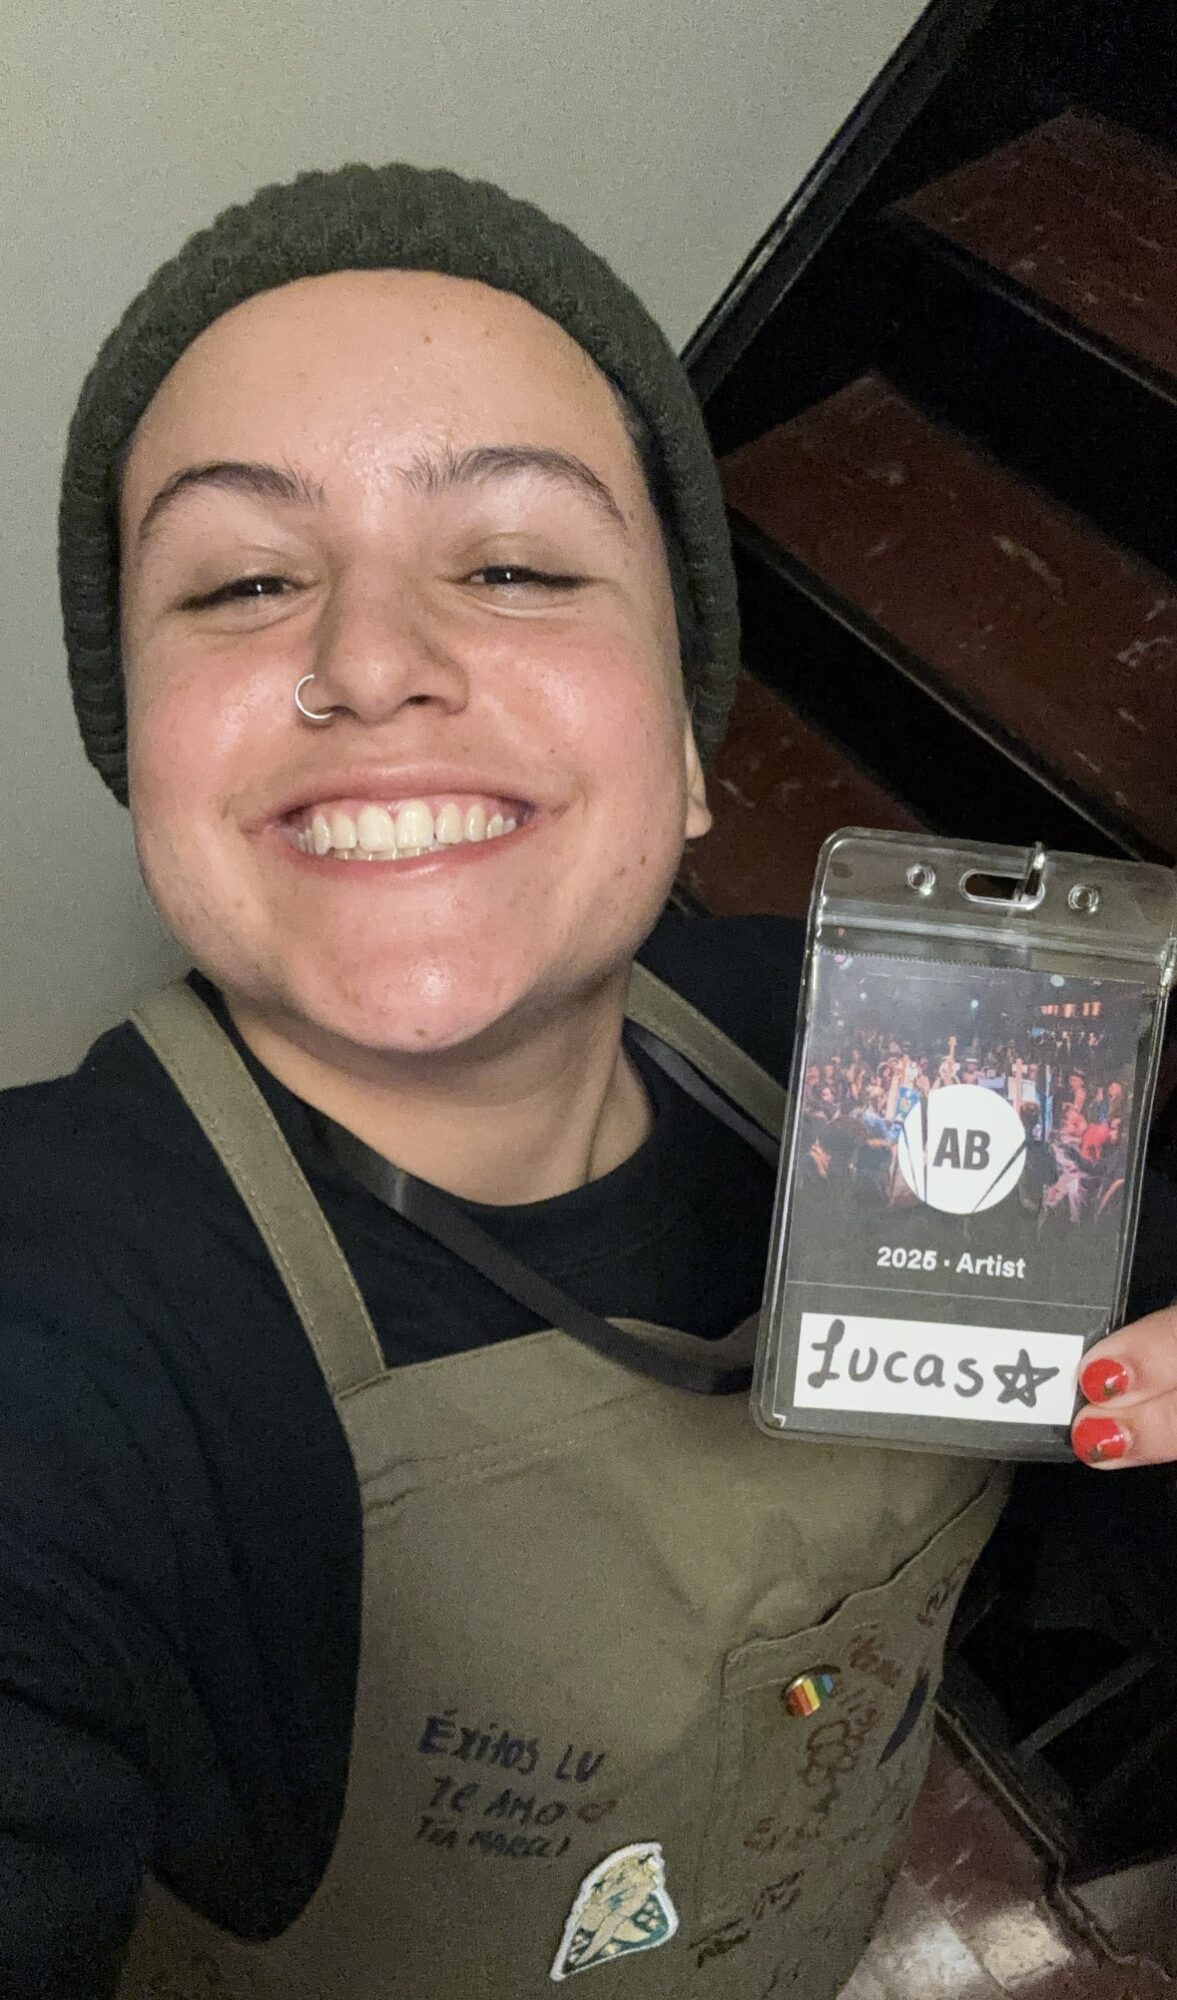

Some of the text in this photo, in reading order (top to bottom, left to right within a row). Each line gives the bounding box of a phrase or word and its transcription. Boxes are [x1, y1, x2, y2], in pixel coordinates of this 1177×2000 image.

[932, 1127, 991, 1171] AB
[876, 1246, 938, 1271] 2025
[955, 1252, 1027, 1279] Artist
[807, 1318, 985, 1398] Lucas
[483, 1787, 567, 1826] AMO
